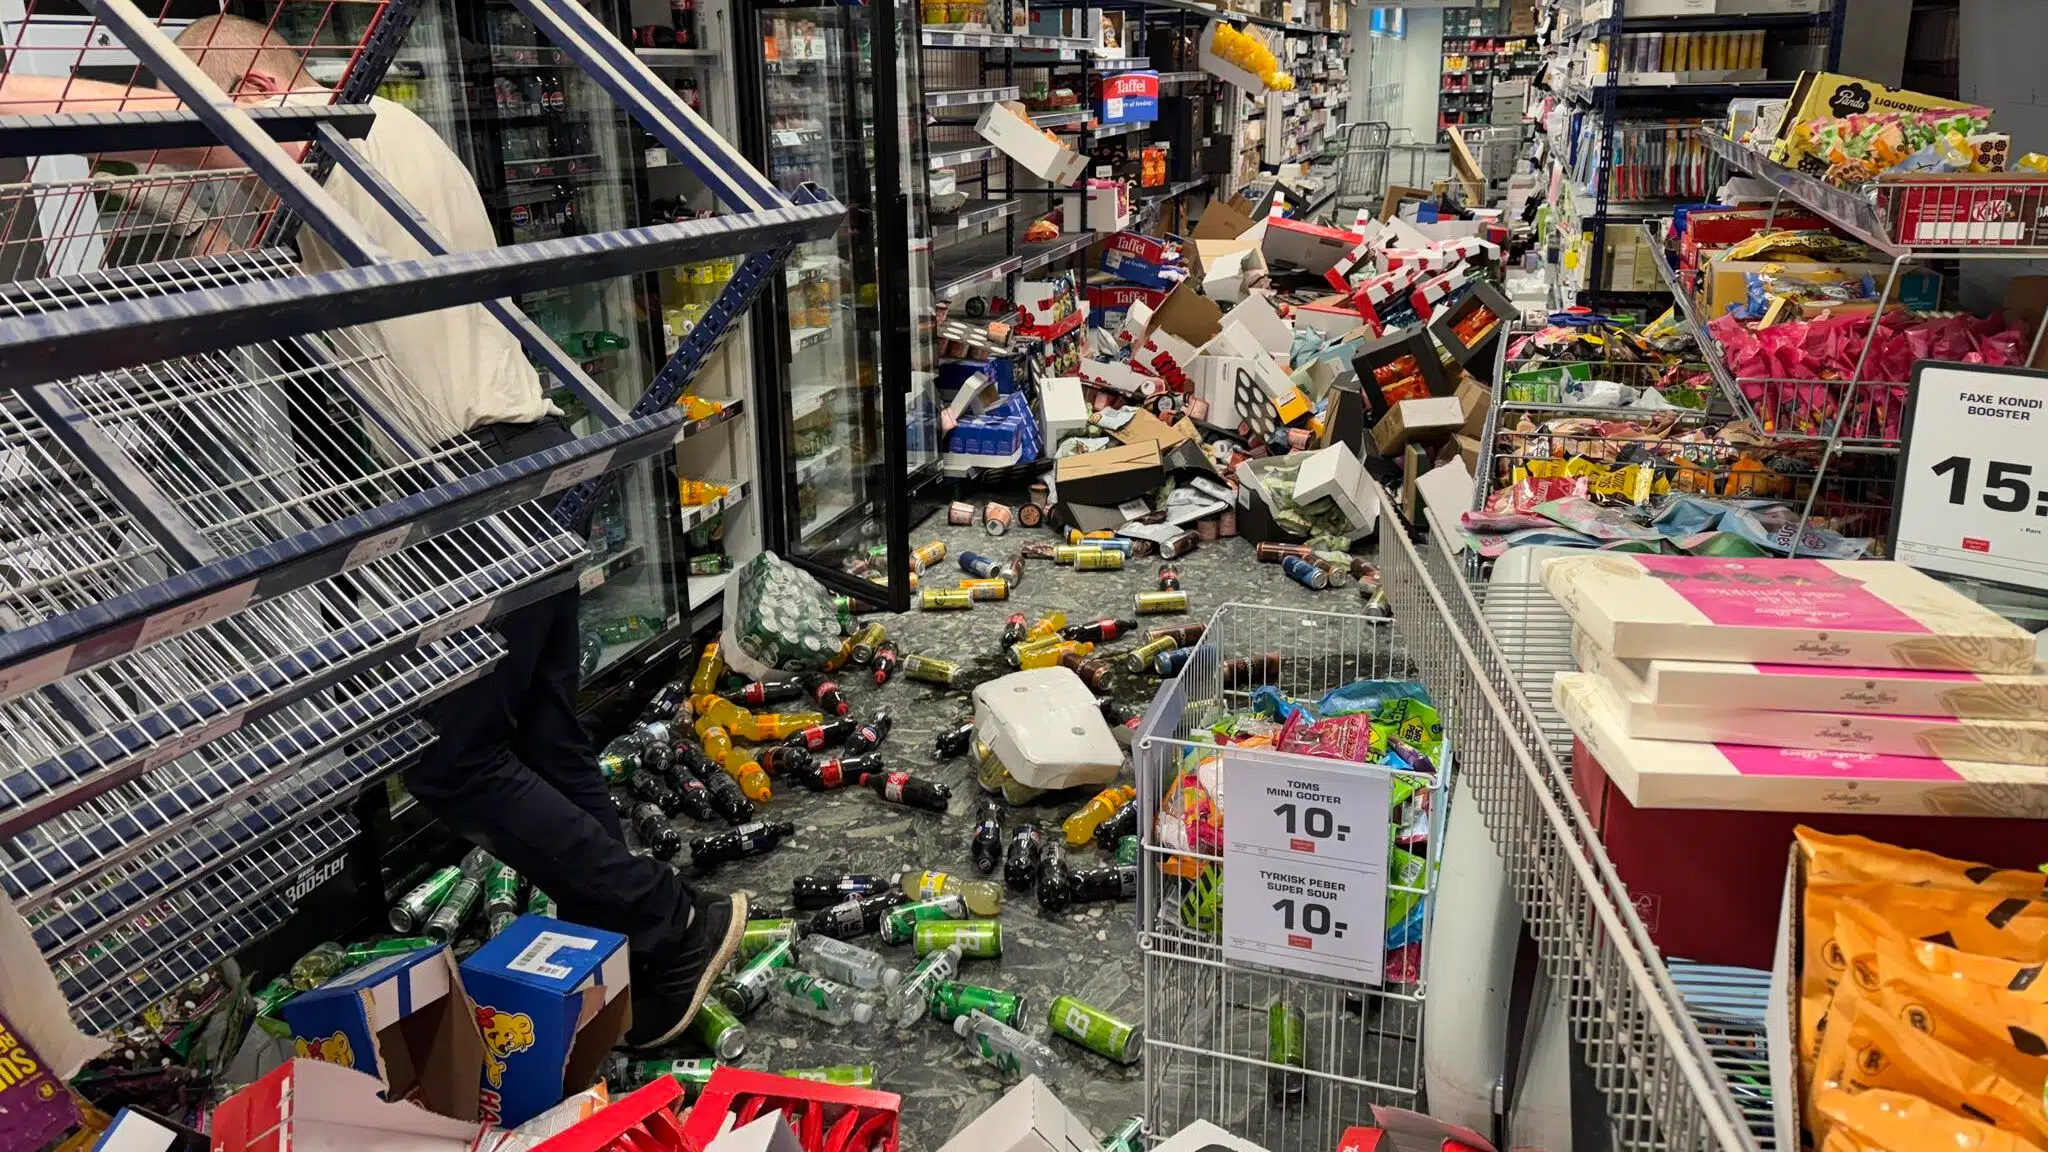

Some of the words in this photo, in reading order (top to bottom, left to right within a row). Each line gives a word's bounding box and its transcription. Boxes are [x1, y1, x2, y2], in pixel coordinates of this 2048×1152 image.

[1115, 79, 1146, 94] Taffel
[1834, 89, 1866, 110] Panda
[1117, 236, 1146, 255] Taffel
[1959, 392, 1994, 405] FAXE
[1999, 396, 2043, 410] KONDI
[1967, 406, 2031, 421] BOOSTER
[1287, 780, 1320, 792] TOMS
[1266, 787, 1293, 798] MINI
[1296, 791, 1342, 805] GODTER
[1259, 870, 1306, 886] TYRKISK
[1309, 878, 1346, 892] PEBER
[1267, 882, 1304, 896] SUPER
[1306, 888, 1338, 901] SOUR
